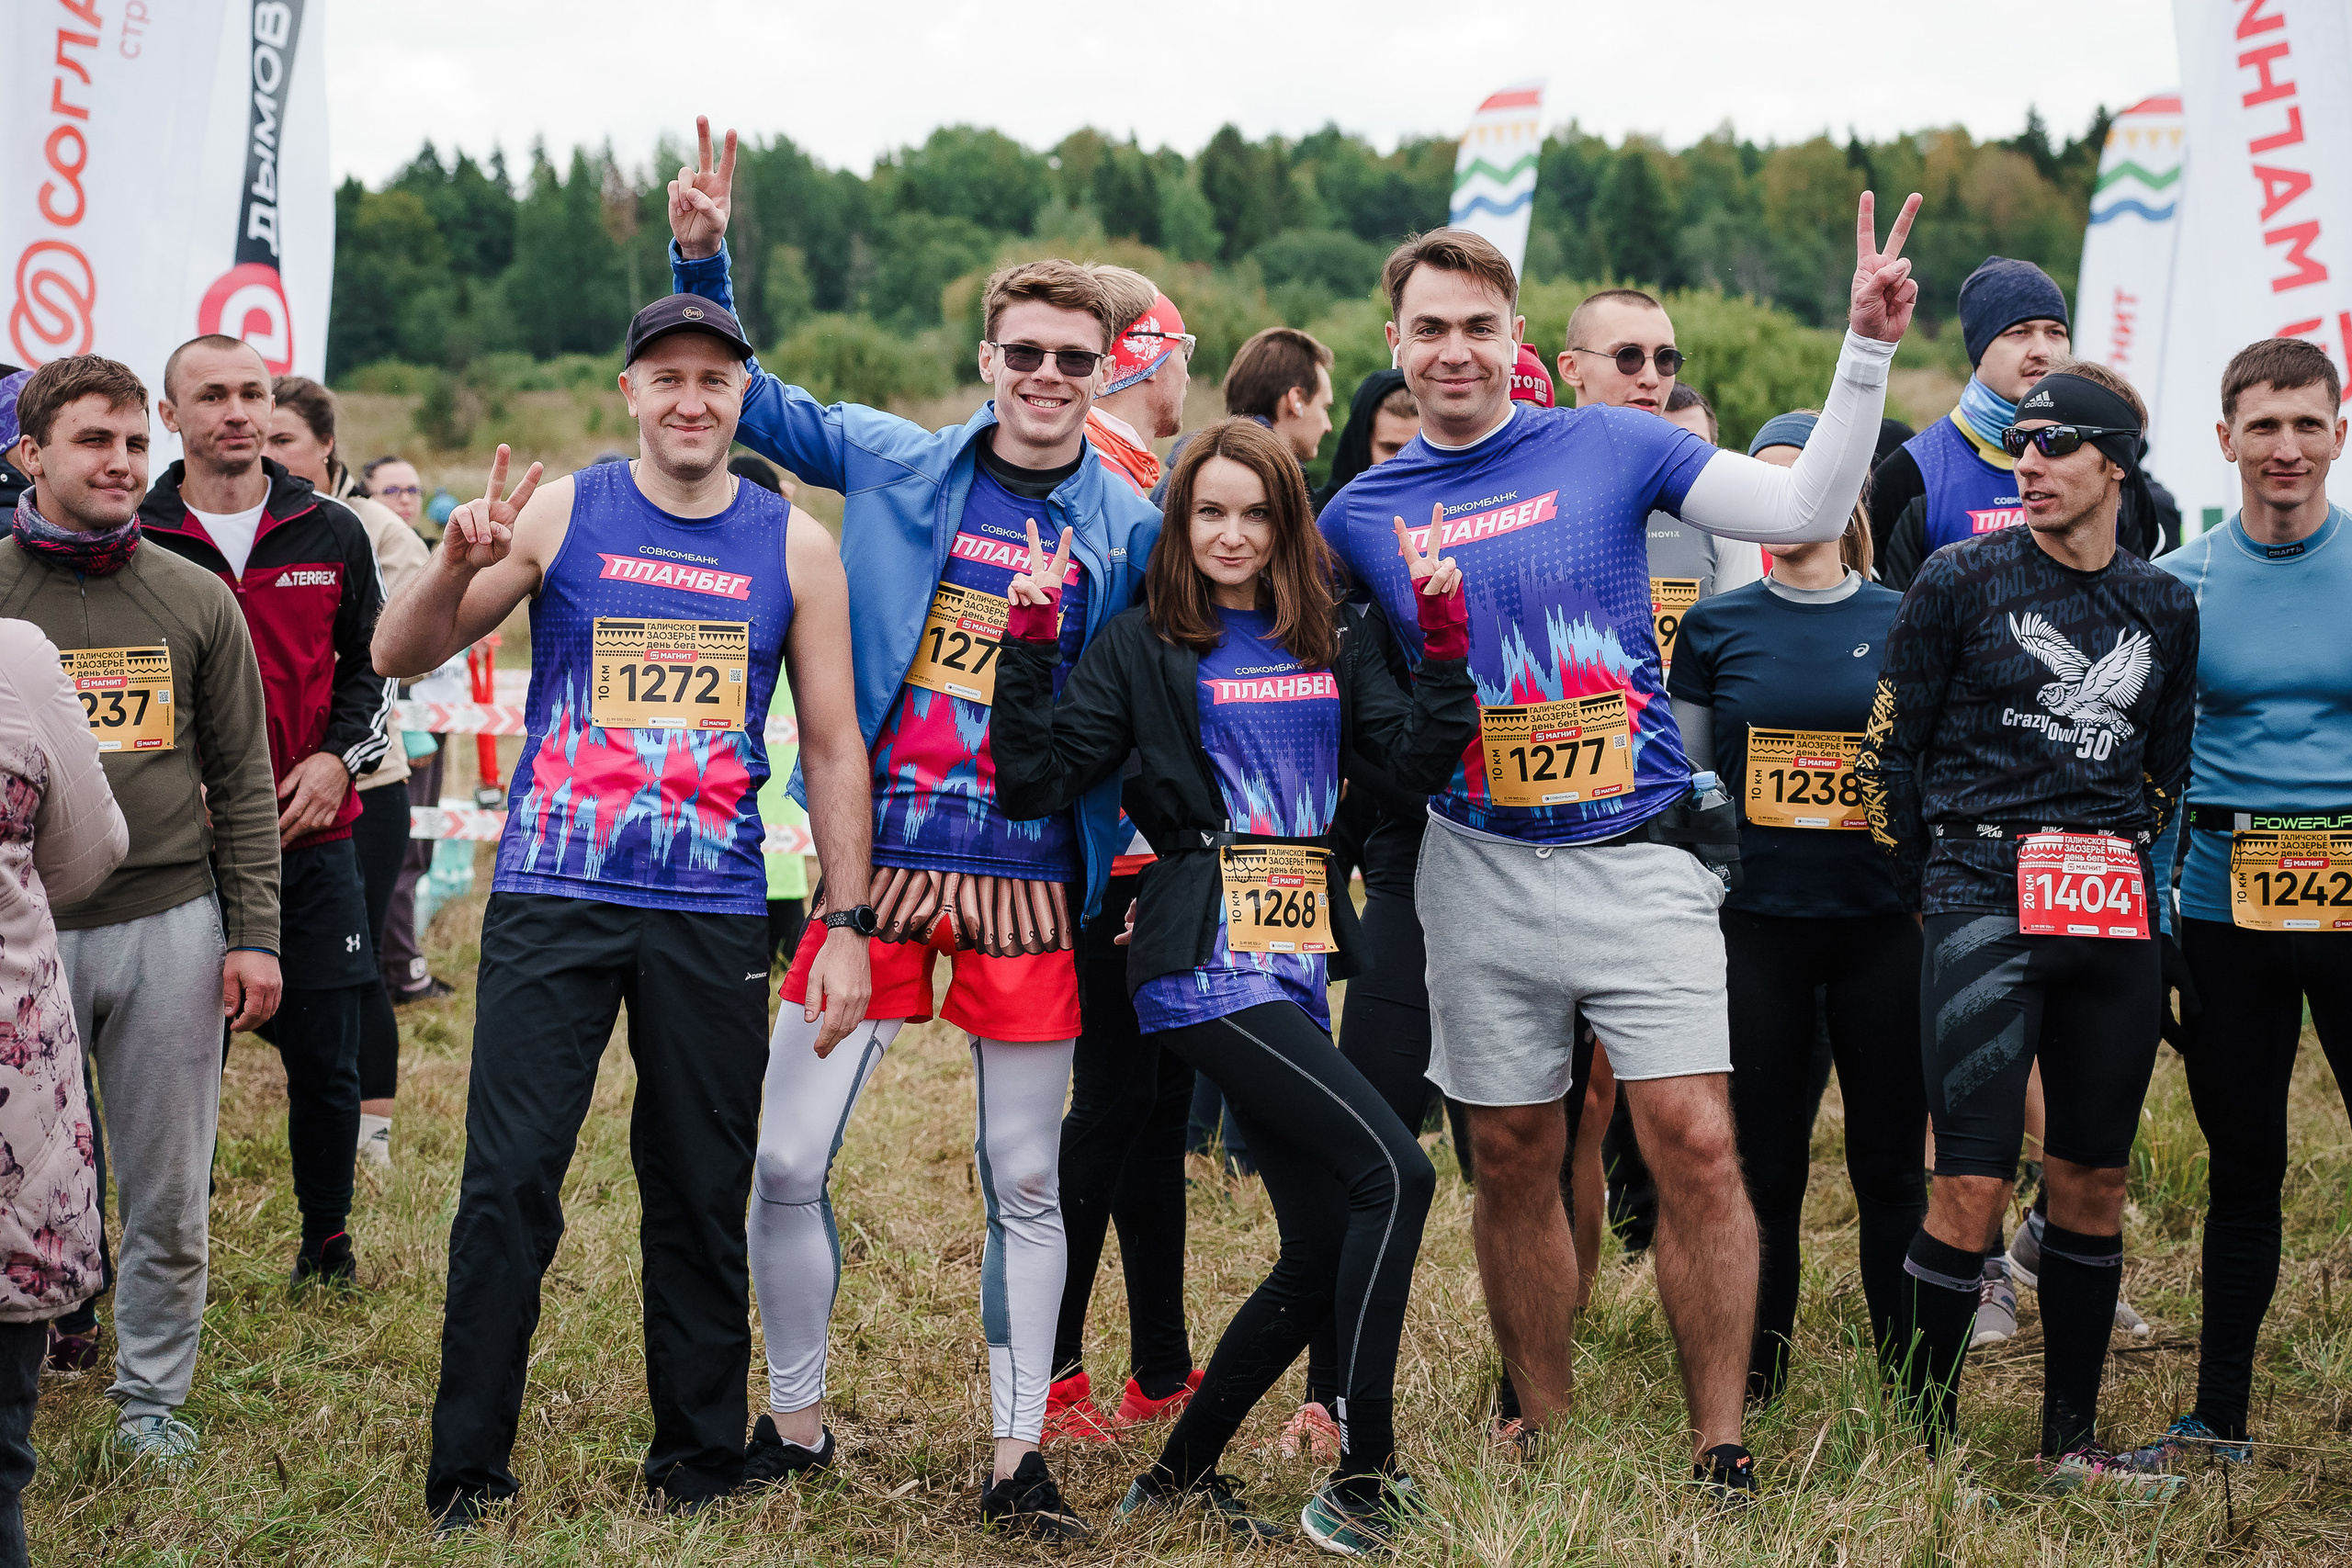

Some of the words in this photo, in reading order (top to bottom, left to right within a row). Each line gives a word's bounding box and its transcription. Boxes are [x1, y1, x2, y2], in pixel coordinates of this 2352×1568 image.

[1509, 367, 1547, 393] rom
[2024, 400, 2054, 408] adidas
[1442, 491, 1518, 516] ОВКОМБАНК
[1976, 510, 2026, 531] ПЛА
[980, 524, 1056, 548] СОВКОМНК
[639, 546, 718, 565] СОВКОМБАНК
[952, 535, 1078, 580] ПЛАНГ
[2268, 548, 2294, 557] CRAFT
[291, 570, 336, 586] TERREX
[609, 558, 745, 595] ПЛАНБЕГ
[967, 592, 1010, 609] ГАЛИЧСКО
[961, 610, 985, 622] день
[988, 615, 1008, 627] бега
[647, 623, 696, 632] ГАЛИЧСКОЕ
[971, 623, 1003, 637] МАГНИТ
[647, 632, 696, 641] ЗАОЗЕРЬЕ
[673, 641, 696, 649] бега
[929, 626, 1000, 675] 127
[76, 651, 124, 660] ГАЛИЧСКОЕ
[660, 652, 692, 660] МАГНИТ
[76, 660, 125, 670] ЗАОЗЕРЬЕ
[76, 670, 100, 679] день
[103, 668, 125, 677] бега
[91, 679, 121, 687] МАГНИТ
[619, 664, 720, 705] 1272
[1217, 675, 1334, 700] ПЛАНБЕГ
[598, 686, 610, 701] 10
[76, 690, 150, 728] 237
[1529, 702, 1577, 714] ГАЛИЧСКОЕ
[1530, 710, 1578, 723] ЗАОЗЕРЬЕ
[1531, 723, 1555, 732] день
[1557, 719, 1579, 728] бега
[1545, 729, 1577, 739] МАГНИТ
[1796, 734, 1841, 742] ГАЛИЧСКОЕ
[2002, 707, 2052, 733] Crazy
[2047, 722, 2079, 743] Owl
[2075, 727, 2113, 761] 50
[1796, 741, 1841, 750] ЗАОЗЕРЬЕ
[1510, 737, 1605, 782] 1277
[1820, 750, 1840, 758] бега
[1492, 767, 1503, 781] 10
[1751, 787, 1762, 800] 10
[1769, 769, 1862, 807] 1238
[2064, 837, 2107, 846] ГАЛИЧСКОЕ
[2280, 841, 2328, 850] ЗАОЗЕРЬЕ
[1269, 849, 1305, 857] ГАЛИЧСКОЕ
[2064, 844, 2106, 853] ЗАОЗЕРЬЕ
[1269, 857, 1305, 866] ЗАОЗЕРЬЕ
[2086, 853, 2106, 862] бега
[1289, 866, 1305, 874] бега
[1280, 877, 1302, 886] МАГНИТ
[2036, 874, 2132, 915] 1404
[2254, 871, 2352, 907] 1242
[2023, 893, 2035, 909] 20
[2237, 891, 2247, 904] 10
[1245, 888, 1316, 929] 1268
[1232, 909, 1241, 924] 10
[1339, 1419, 1351, 1455] NIKE
